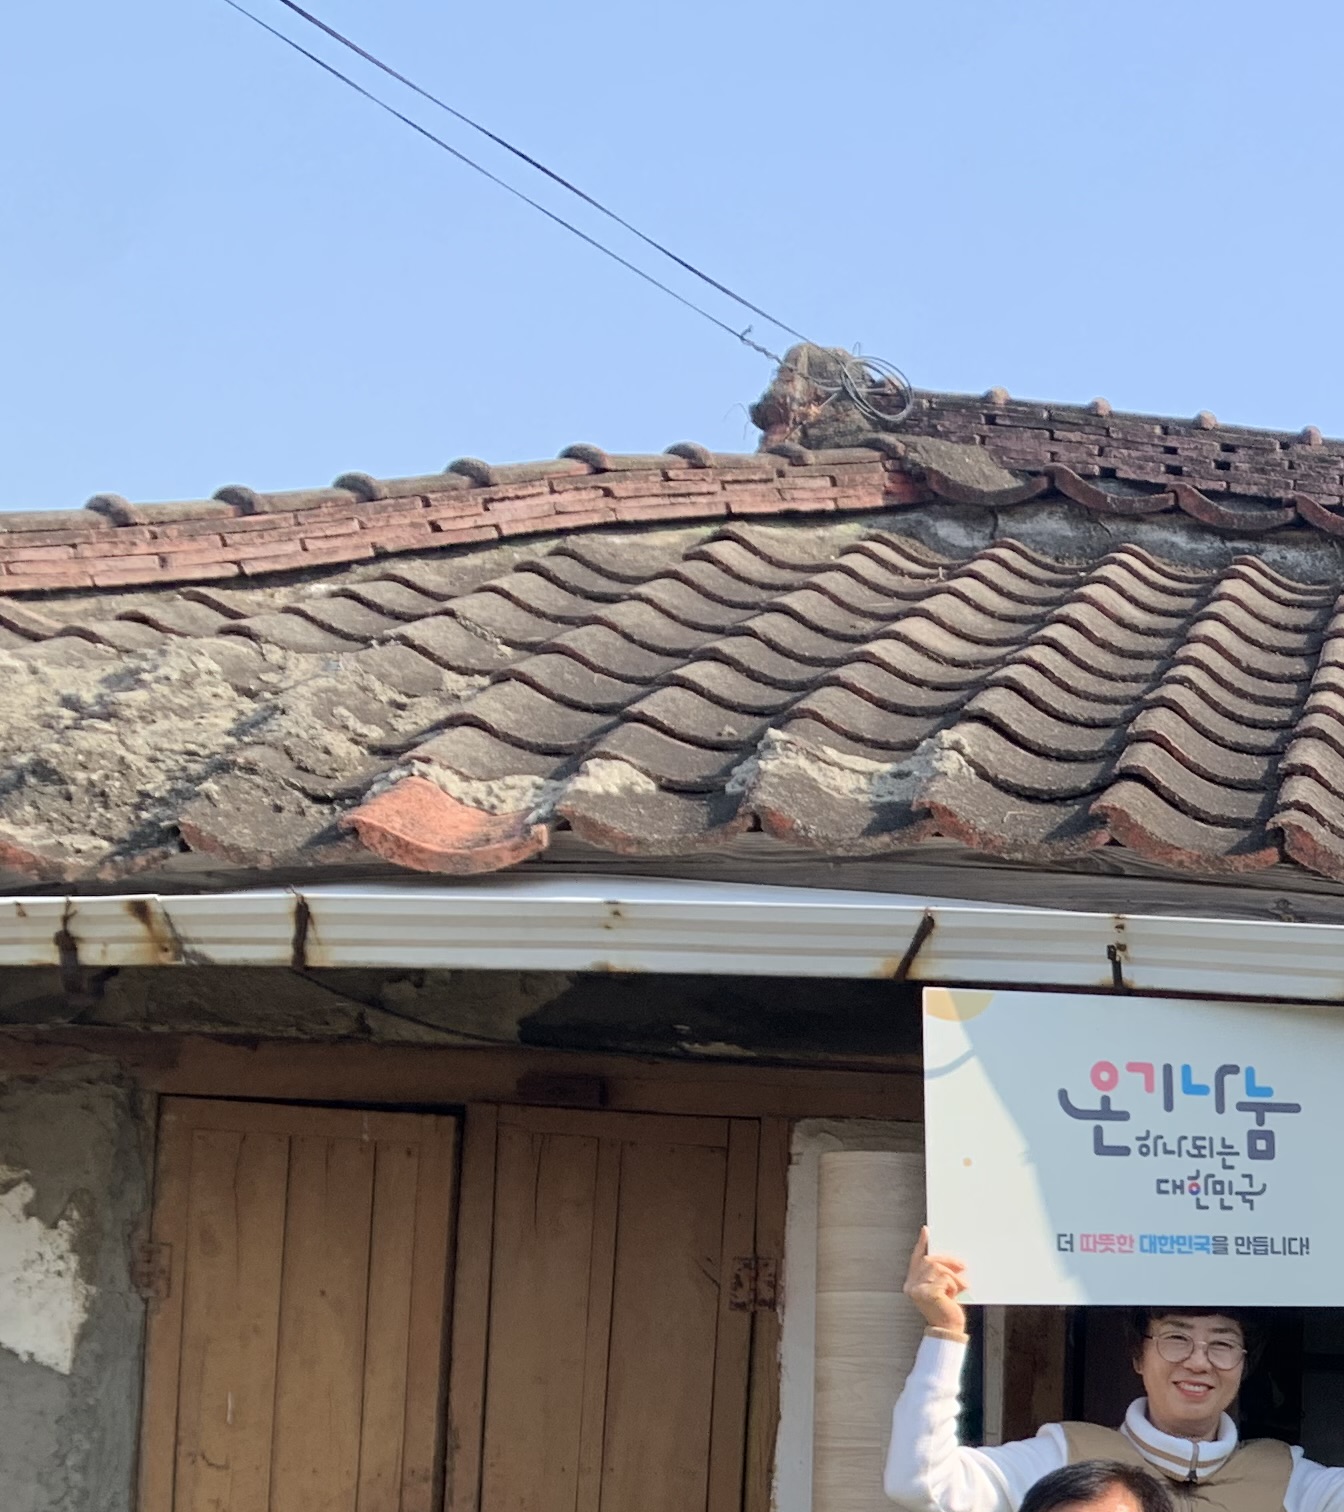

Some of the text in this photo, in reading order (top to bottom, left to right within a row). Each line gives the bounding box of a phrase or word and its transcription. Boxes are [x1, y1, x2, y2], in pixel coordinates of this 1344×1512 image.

[1058, 1060, 1302, 1161] 온기나눔
[1136, 1130, 1240, 1170] 하나되는
[1156, 1170, 1267, 1210] 대한민국
[1057, 1233, 1310, 1257] 더 따뜻한 대한민국을 만듭니다!
